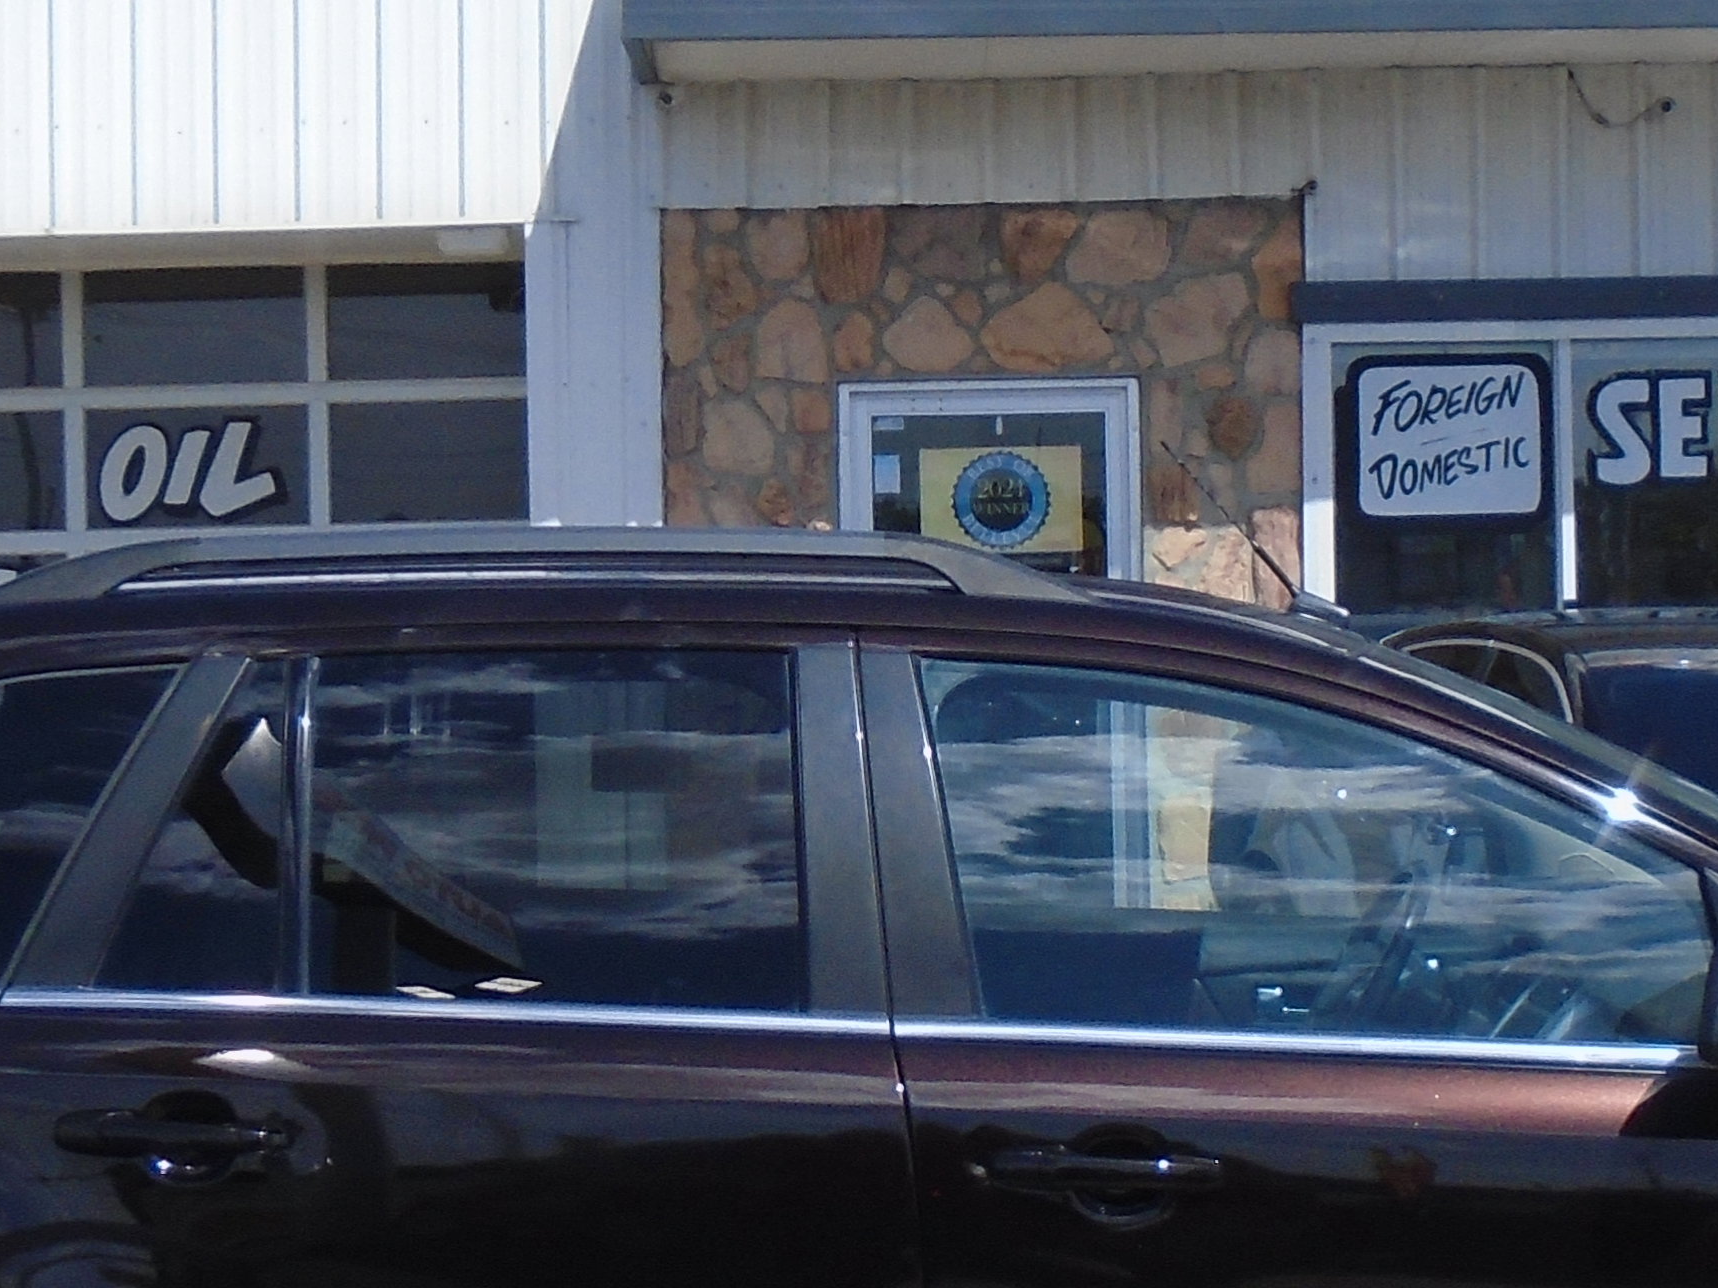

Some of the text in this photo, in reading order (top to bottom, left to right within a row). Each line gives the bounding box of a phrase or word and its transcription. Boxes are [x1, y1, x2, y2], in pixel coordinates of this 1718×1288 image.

[1371, 371, 1525, 437] FOREIGN
[99, 421, 277, 522] OIL
[1368, 436, 1530, 500] DOMESTIC
